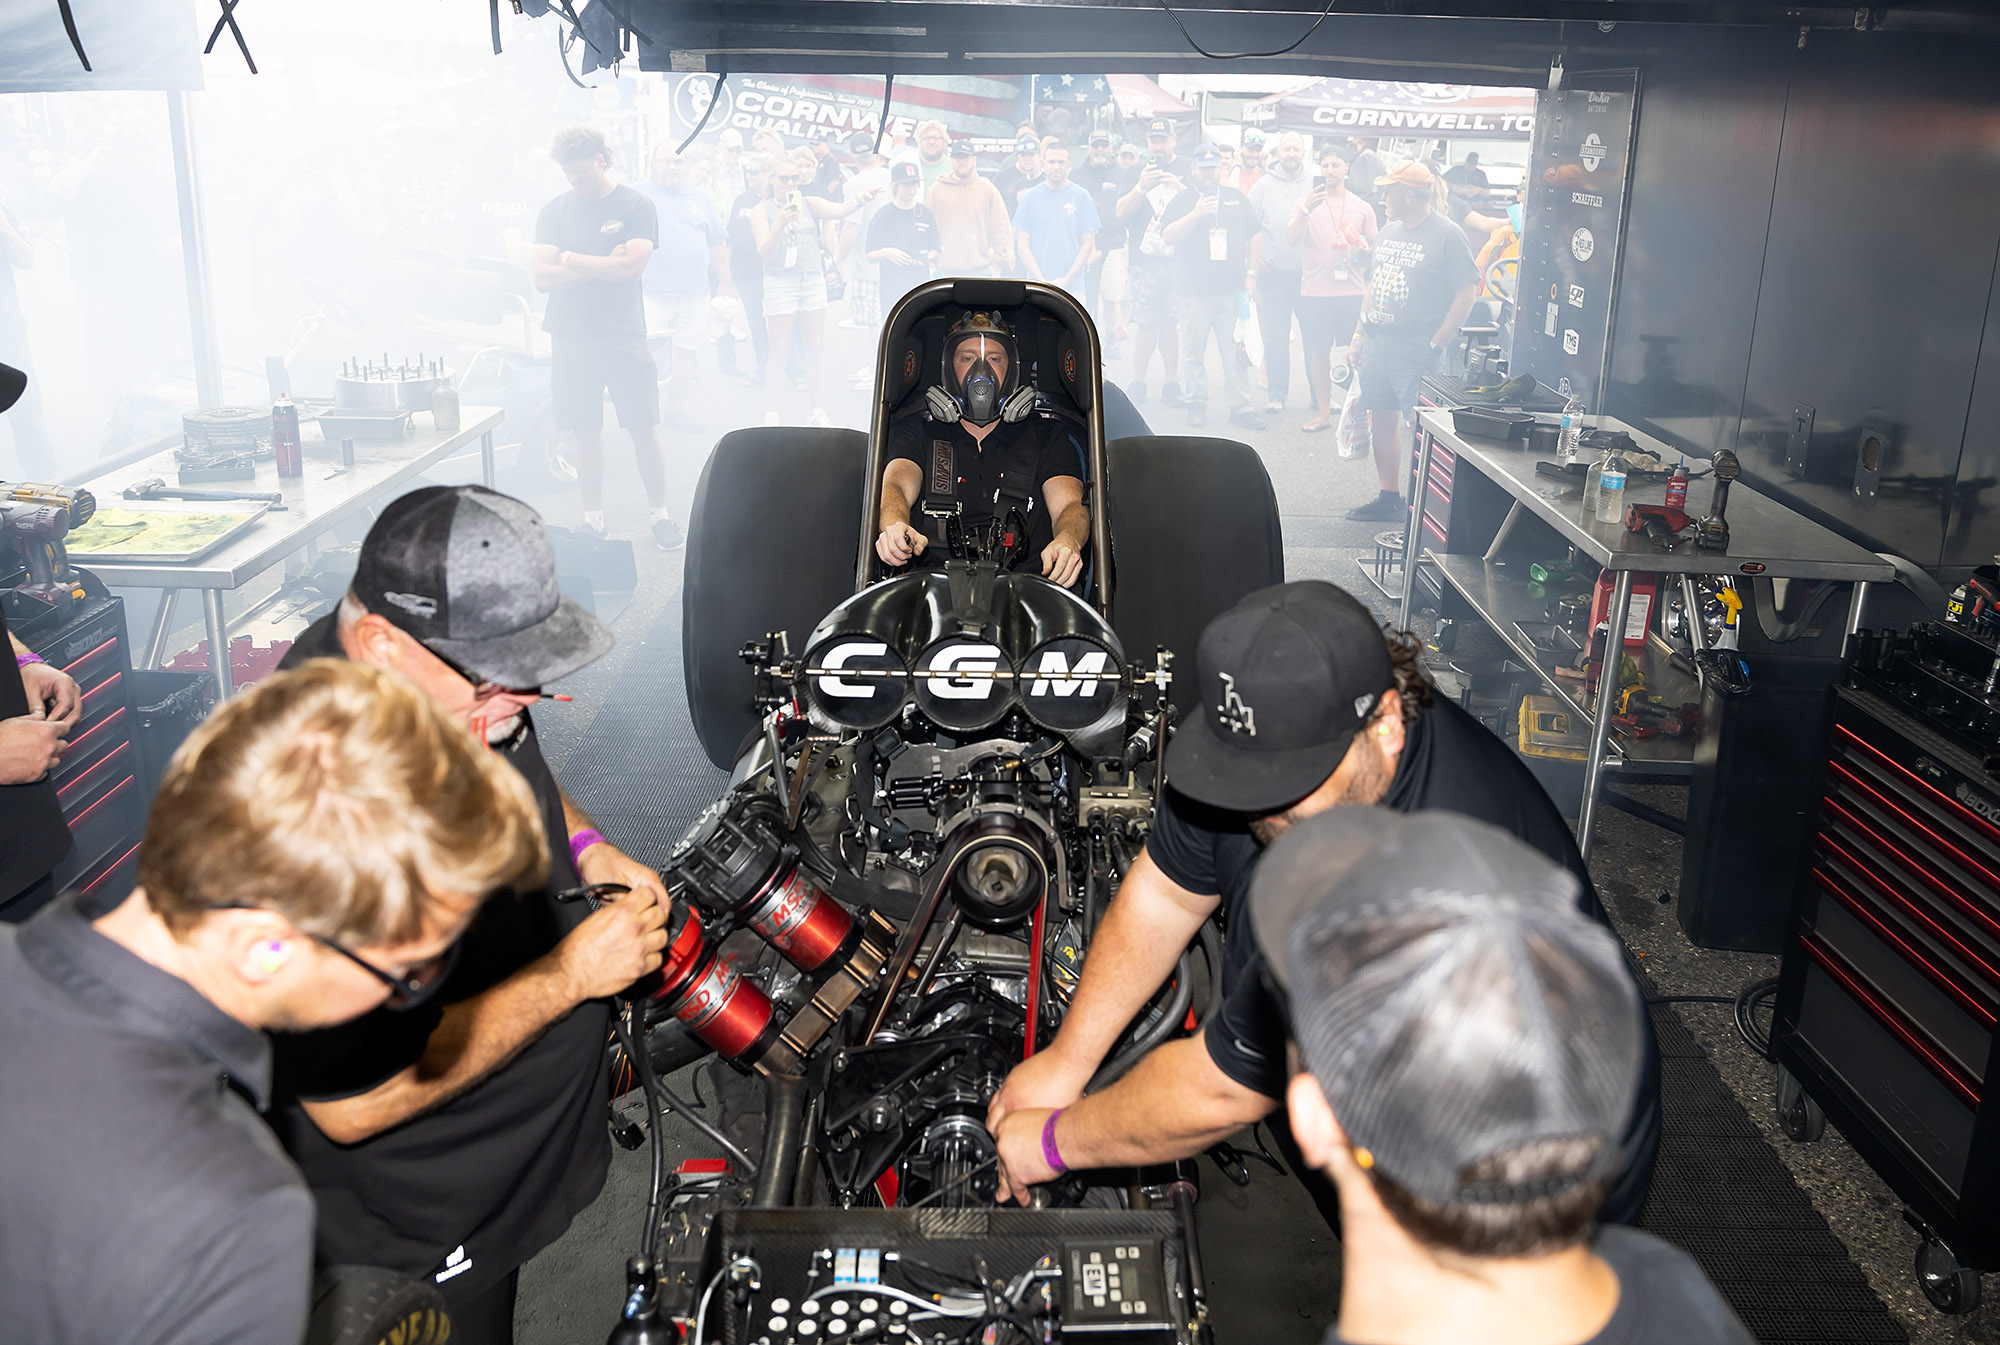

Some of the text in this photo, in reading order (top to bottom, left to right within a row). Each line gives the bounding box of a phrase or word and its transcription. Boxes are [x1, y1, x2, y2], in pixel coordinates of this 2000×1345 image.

[731, 112, 853, 145] QUALITY
[1571, 192, 1603, 208] SCHAEFFLER
[1388, 240, 1407, 250] YOUR
[1406, 242, 1423, 253] CAR
[1400, 249, 1425, 262] SCARE
[1375, 253, 1417, 268] YOU A LITTLE
[936, 443, 949, 490] SIMPSON
[1217, 671, 1257, 737] LA
[772, 881, 807, 928] MSD
